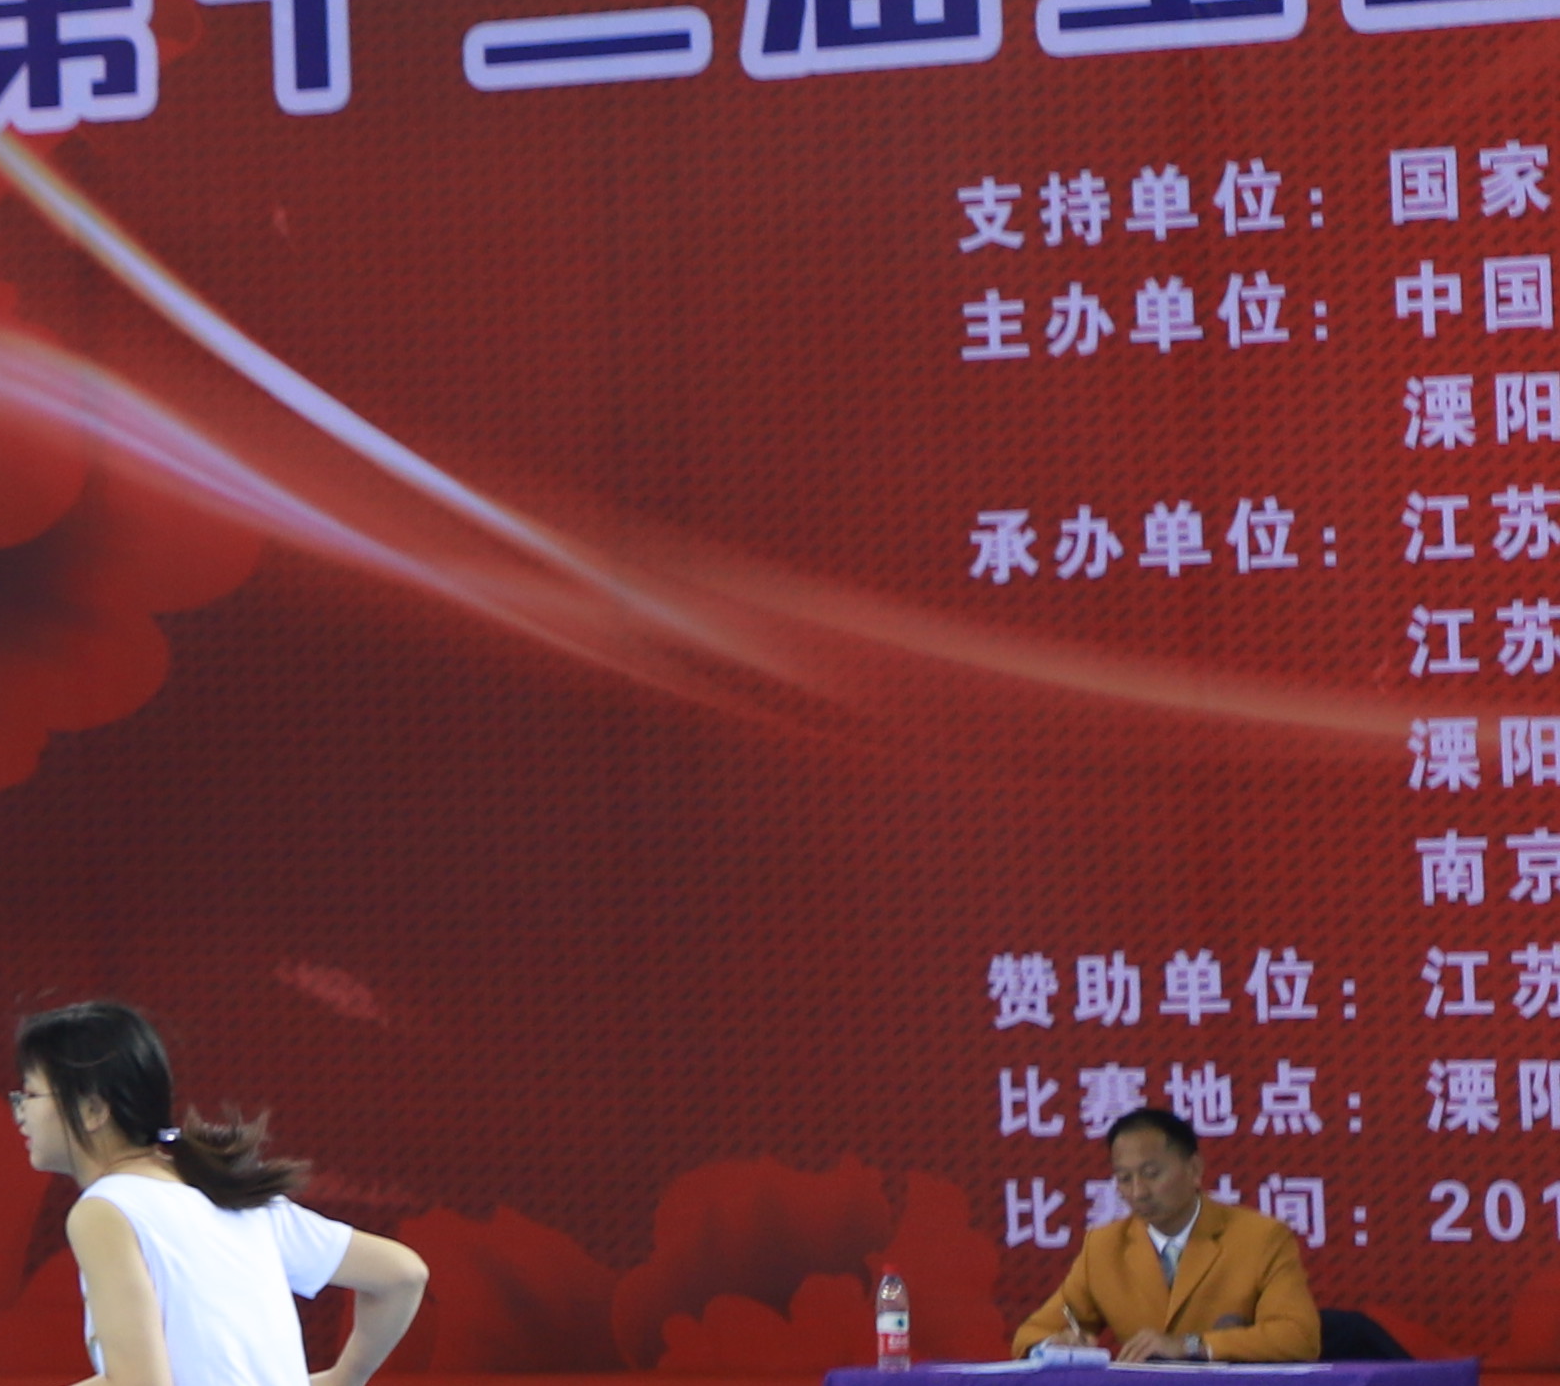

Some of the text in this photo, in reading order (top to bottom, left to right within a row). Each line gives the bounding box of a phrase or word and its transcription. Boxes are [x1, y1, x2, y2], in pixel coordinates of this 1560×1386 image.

[1394, 254, 1554, 338] 中国
[1402, 371, 1560, 450] 溧阳
[1401, 483, 1560, 564] 江苏
[1406, 598, 1560, 678] 江苏
[1407, 716, 1560, 792] 溧阳
[1415, 827, 1560, 906] 南京
